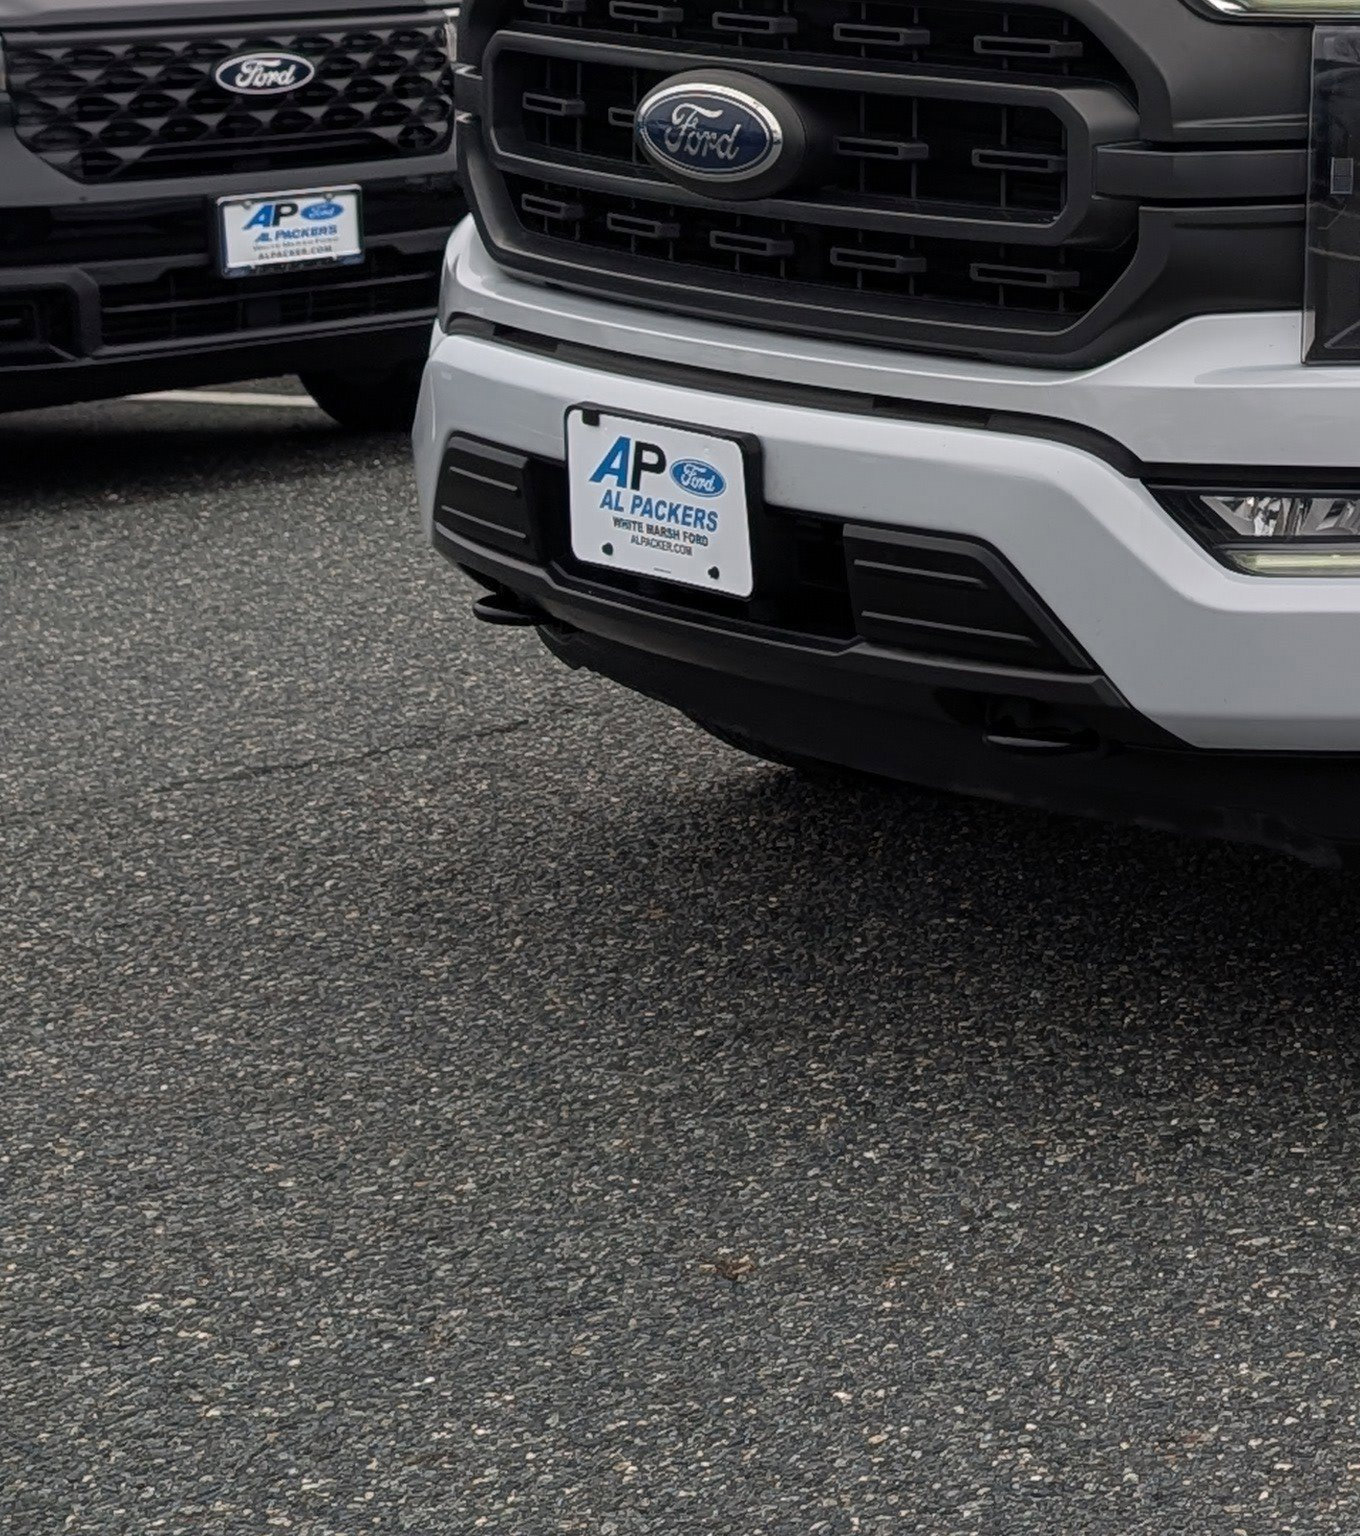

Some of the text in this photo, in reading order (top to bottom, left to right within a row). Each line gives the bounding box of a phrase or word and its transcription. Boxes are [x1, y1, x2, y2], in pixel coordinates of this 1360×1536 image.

[235, 59, 296, 87] Ford
[664, 102, 742, 160] Ford
[242, 201, 298, 230] AP
[275, 224, 338, 240] PACKERS
[589, 435, 667, 491] AP
[600, 489, 718, 532] AL PACKERS
